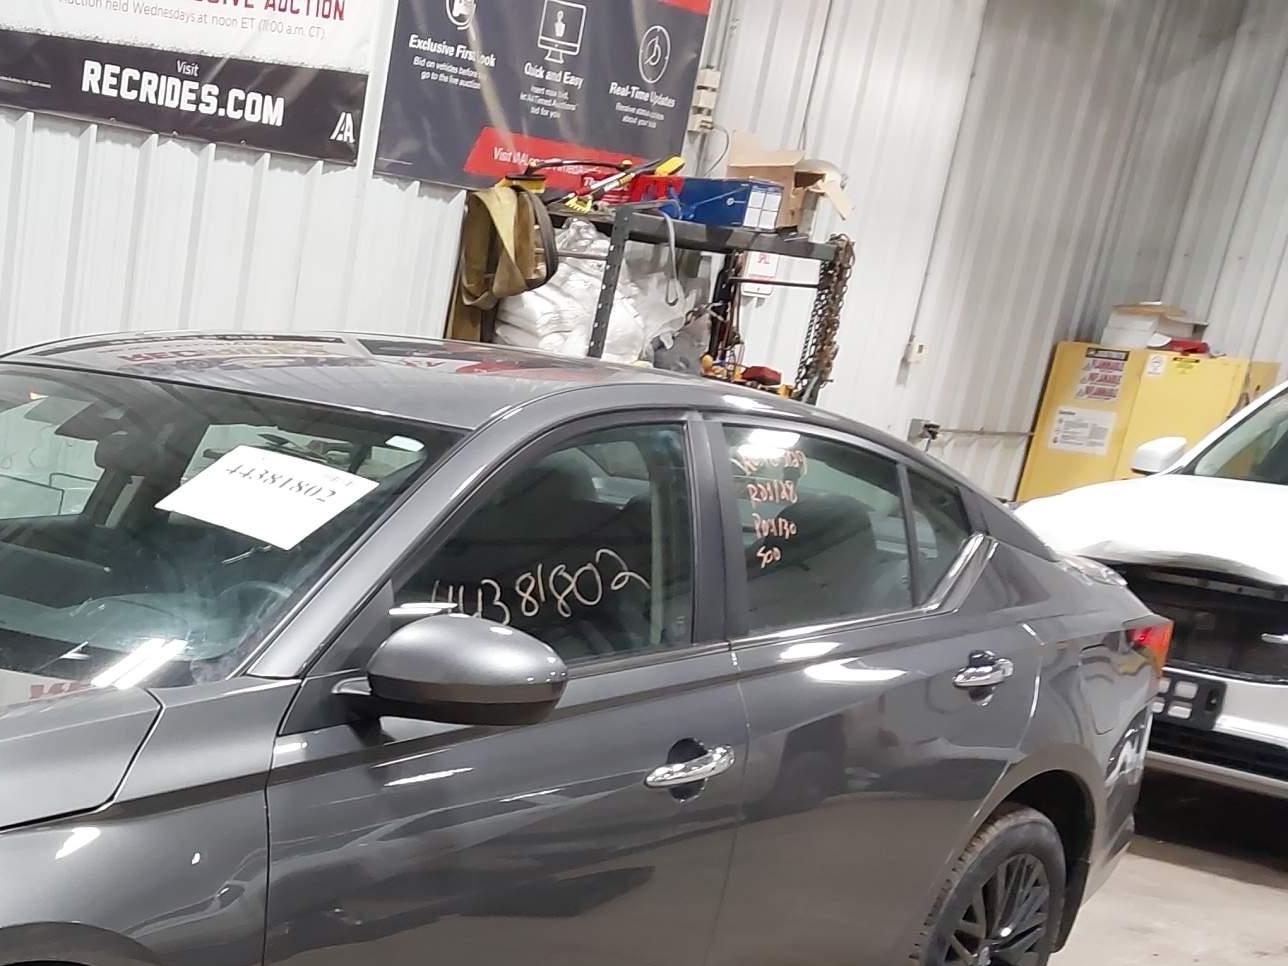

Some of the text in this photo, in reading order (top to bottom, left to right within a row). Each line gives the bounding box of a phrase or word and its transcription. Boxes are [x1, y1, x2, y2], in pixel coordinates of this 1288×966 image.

[58, 0, 102, 8] uction
[105, 0, 129, 12] held
[132, 1, 195, 24] Wednesdays
[198, 12, 208, 24] at
[212, 15, 238, 27] noon
[241, 17, 256, 29] ET
[409, 34, 455, 57] Exclusive
[176, 59, 200, 77] Visit
[524, 62, 584, 90] Quick and Easy
[81, 60, 286, 127] RECRIDES.COM
[609, 82, 676, 108] Real-Time Updates
[225, 464, 337, 503] 44381802
